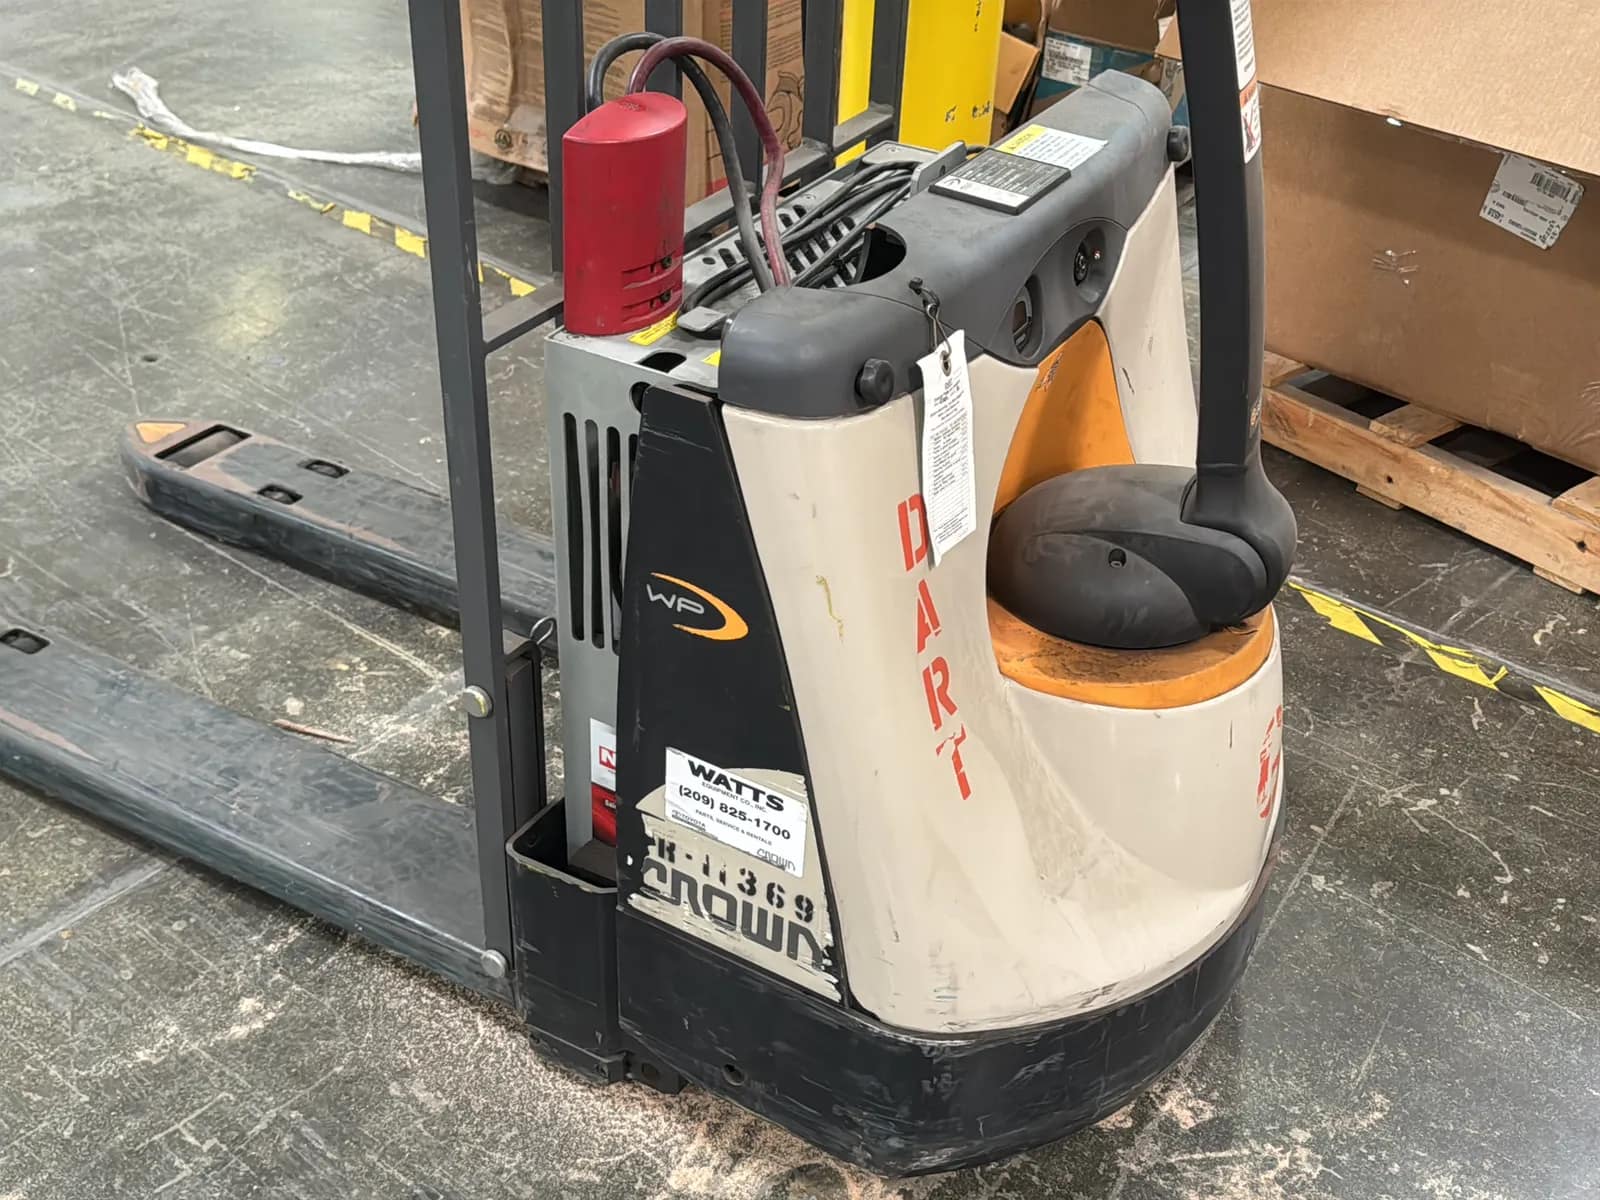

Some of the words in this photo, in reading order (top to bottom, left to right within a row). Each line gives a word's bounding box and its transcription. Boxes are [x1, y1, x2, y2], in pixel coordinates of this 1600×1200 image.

[646, 583, 705, 615] WP
[896, 492, 972, 801] DART
[679, 785, 715, 810] (209)
[719, 802, 791, 840] 825-1700
[688, 759, 784, 812] WATTS
[702, 781, 738, 800] EQUIPMENT
[639, 857, 824, 971] CROWN
